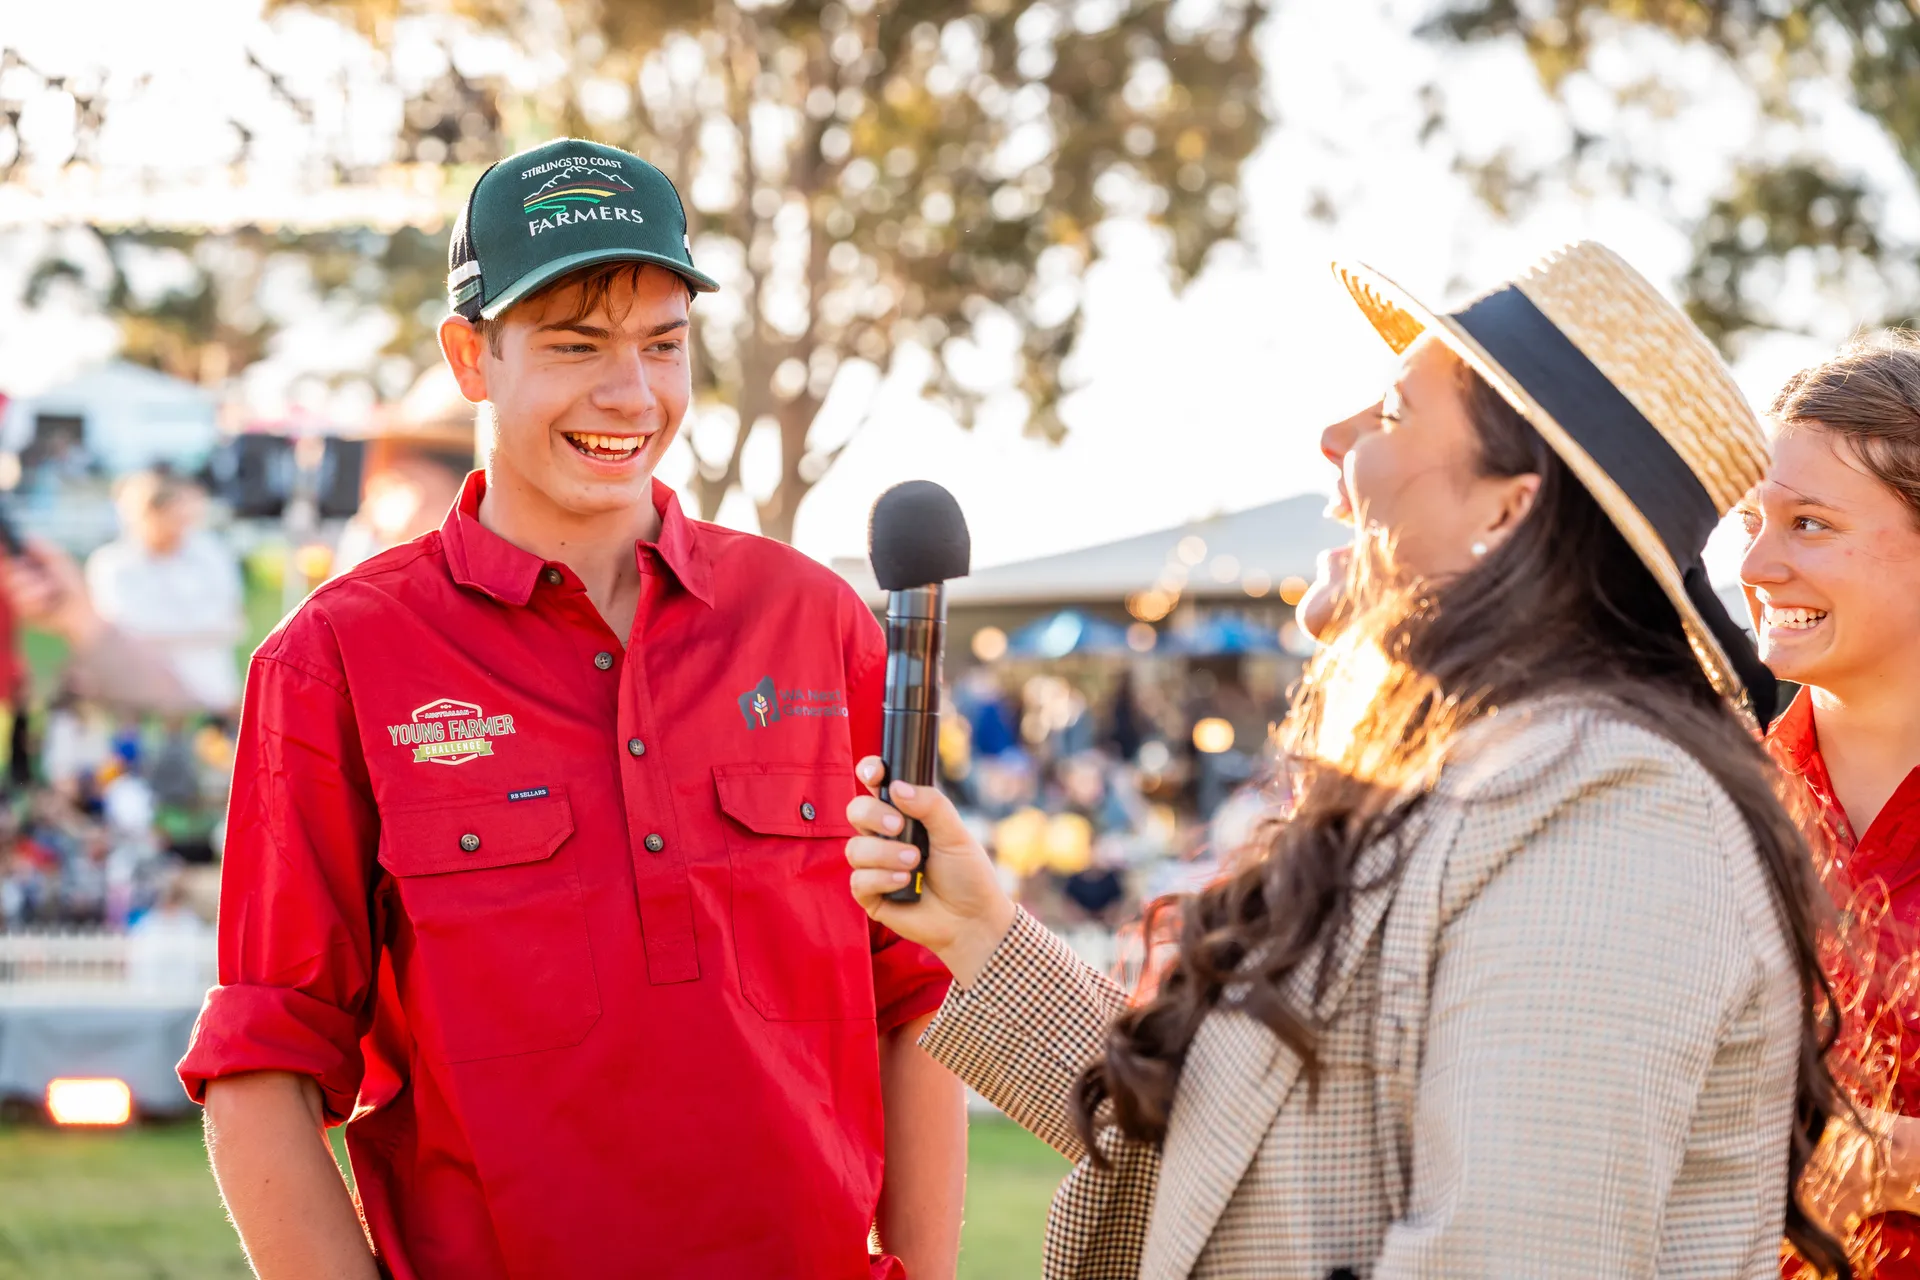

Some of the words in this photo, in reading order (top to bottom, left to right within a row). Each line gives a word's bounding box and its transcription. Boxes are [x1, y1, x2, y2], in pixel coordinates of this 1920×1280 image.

[521, 158, 572, 180] STIRLINGS
[572, 157, 587, 165] TO
[590, 157, 622, 168] COAST
[528, 207, 643, 236] FARMERS
[779, 689, 804, 700] WA
[808, 689, 841, 701] Next
[425, 710, 469, 718] AUSTRALIAN
[387, 722, 445, 746] YOUNG
[448, 714, 516, 740] FARMER
[425, 741, 481, 755] CHALLENGE
[519, 789, 547, 798] SELLARS
